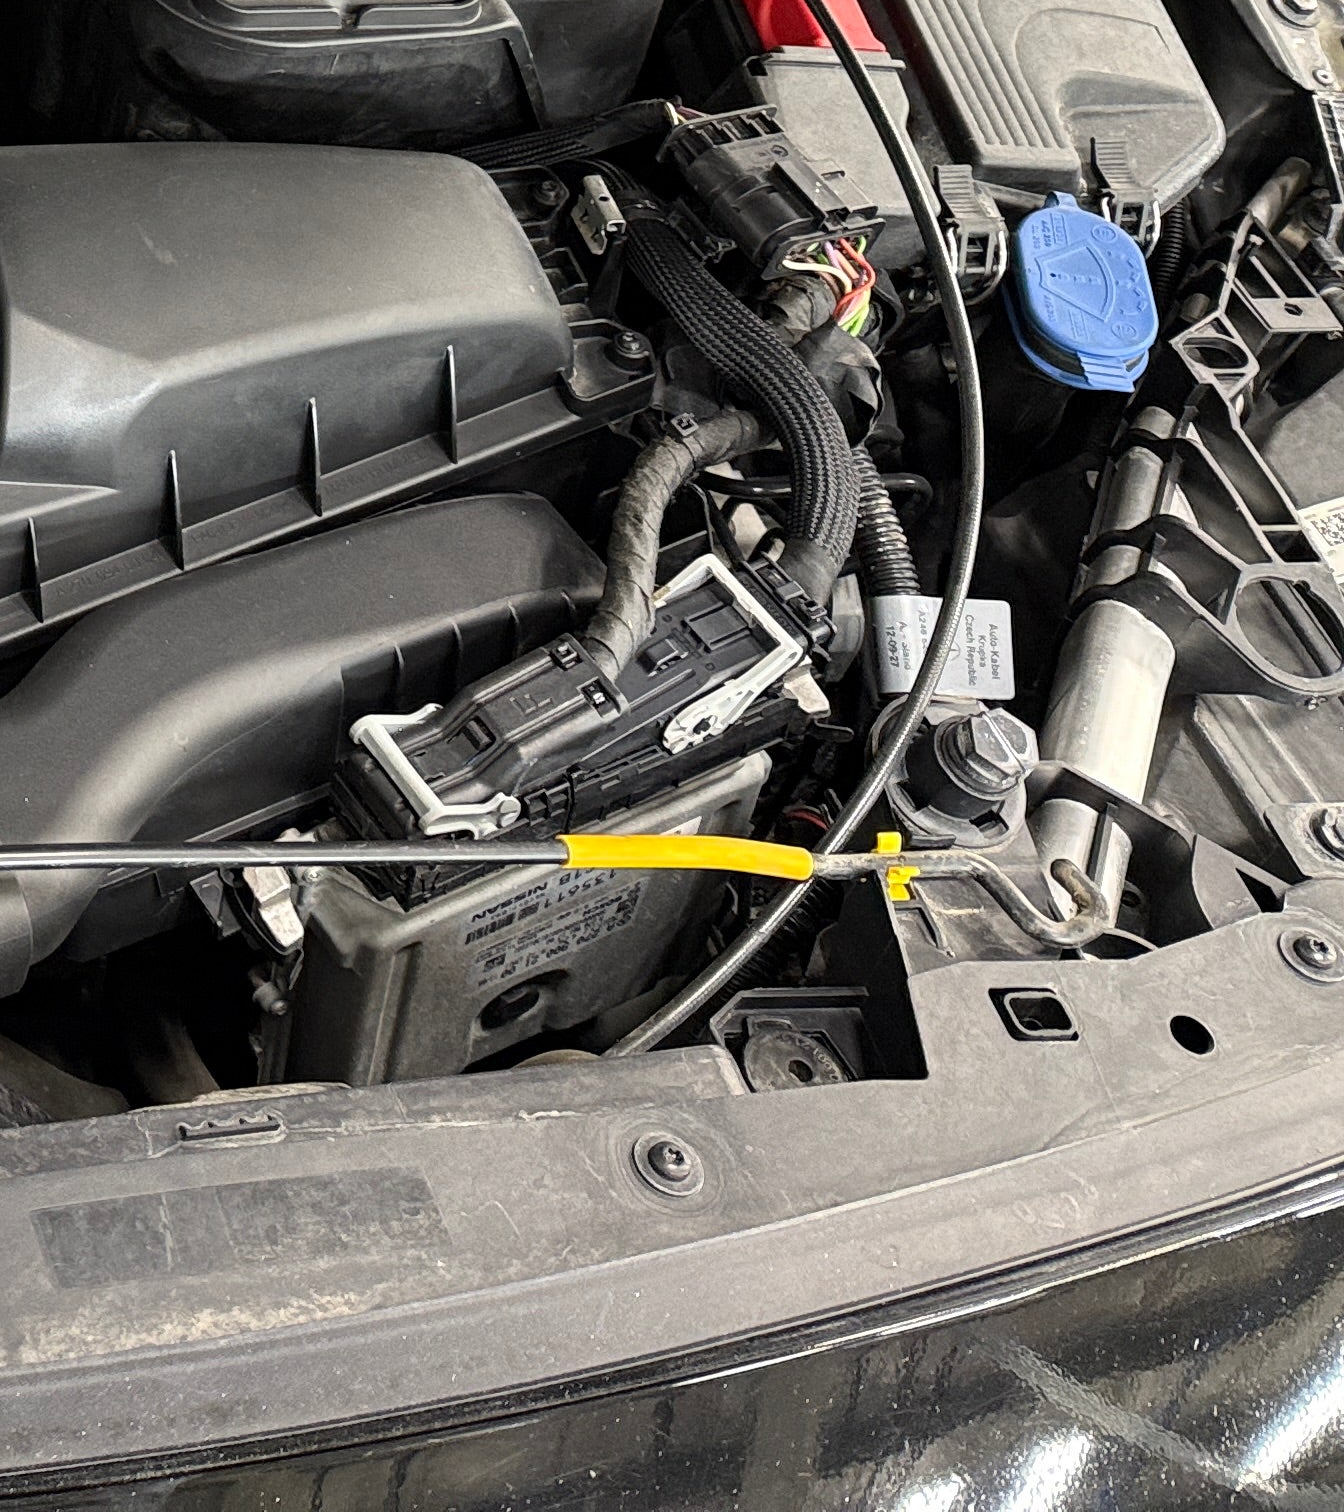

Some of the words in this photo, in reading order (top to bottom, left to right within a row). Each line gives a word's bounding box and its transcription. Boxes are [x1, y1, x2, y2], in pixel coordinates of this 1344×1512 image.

[965, 614, 975, 643] Czech
[966, 646, 978, 686] Republic
[978, 635, 986, 667] Krupka
[989, 623, 1000, 680] Auto-Kabel
[471, 882, 548, 923] NISSAN
